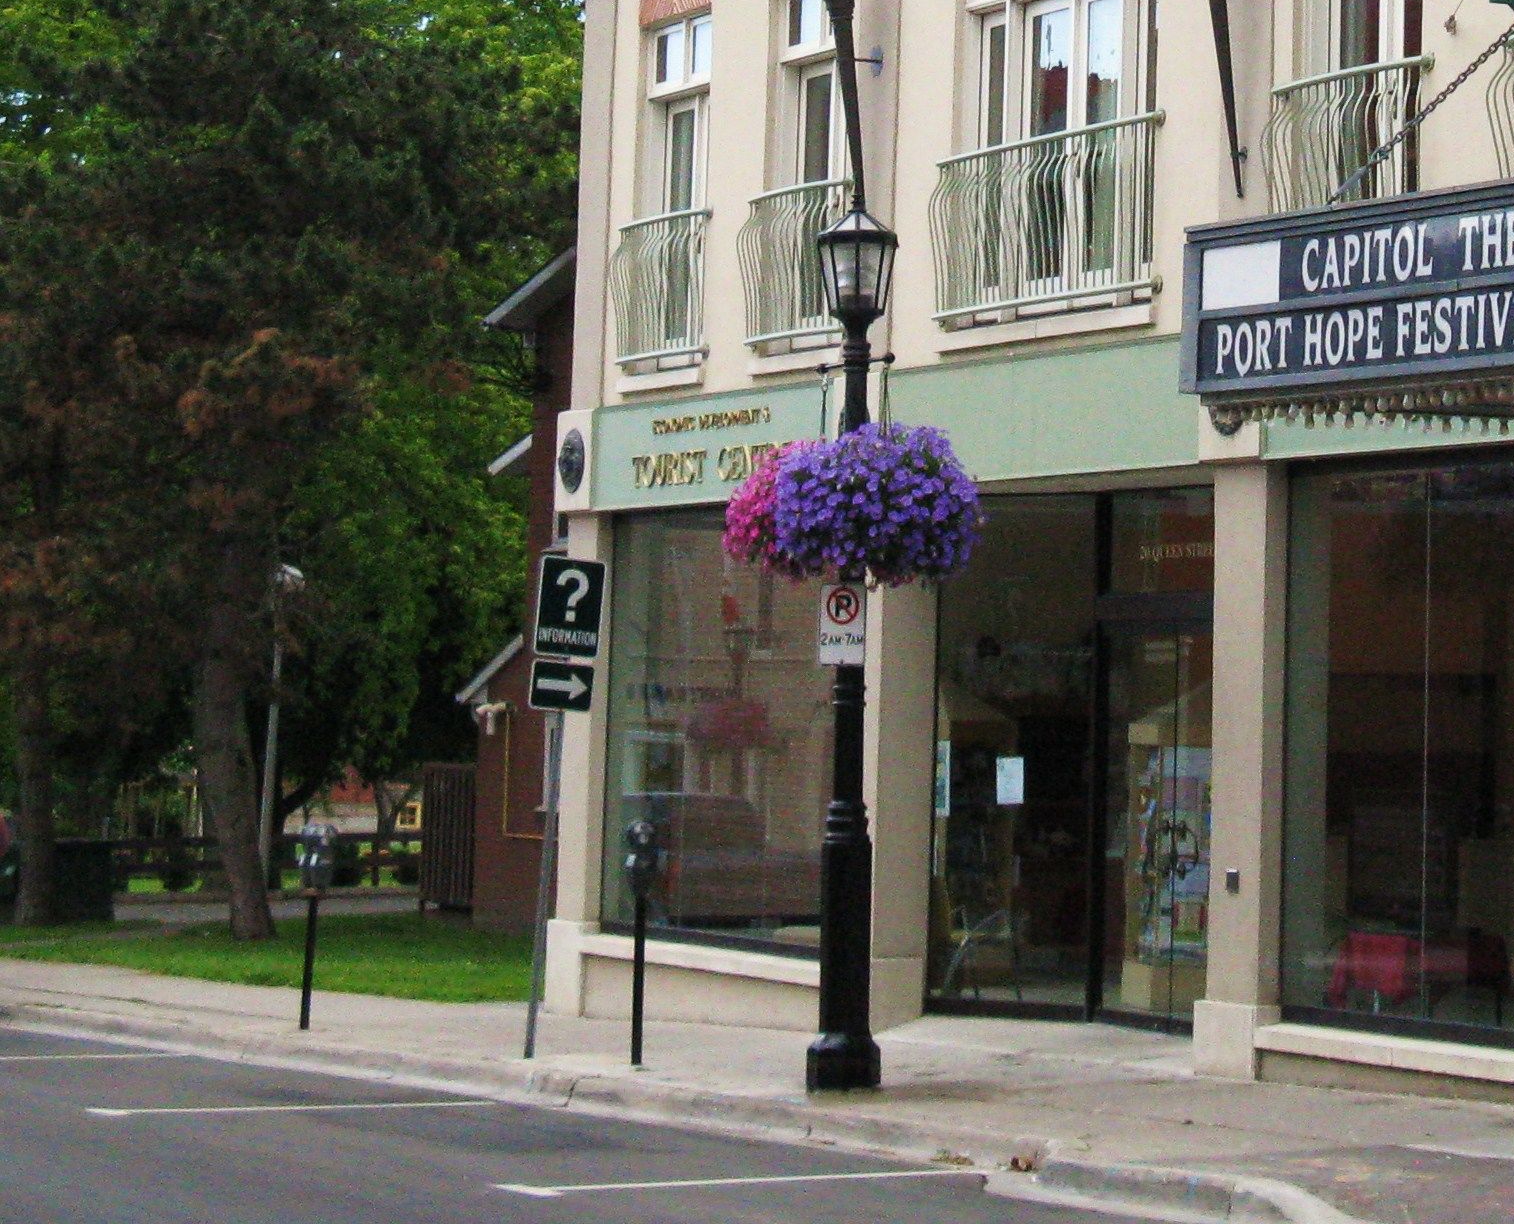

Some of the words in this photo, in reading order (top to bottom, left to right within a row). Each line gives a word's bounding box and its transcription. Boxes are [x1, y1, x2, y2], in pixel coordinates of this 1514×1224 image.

[1301, 223, 1434, 293] CAPITOL
[1215, 315, 1293, 378] PORT
[1303, 306, 1383, 367] HOPE
[537, 627, 597, 647] INFORMATION
